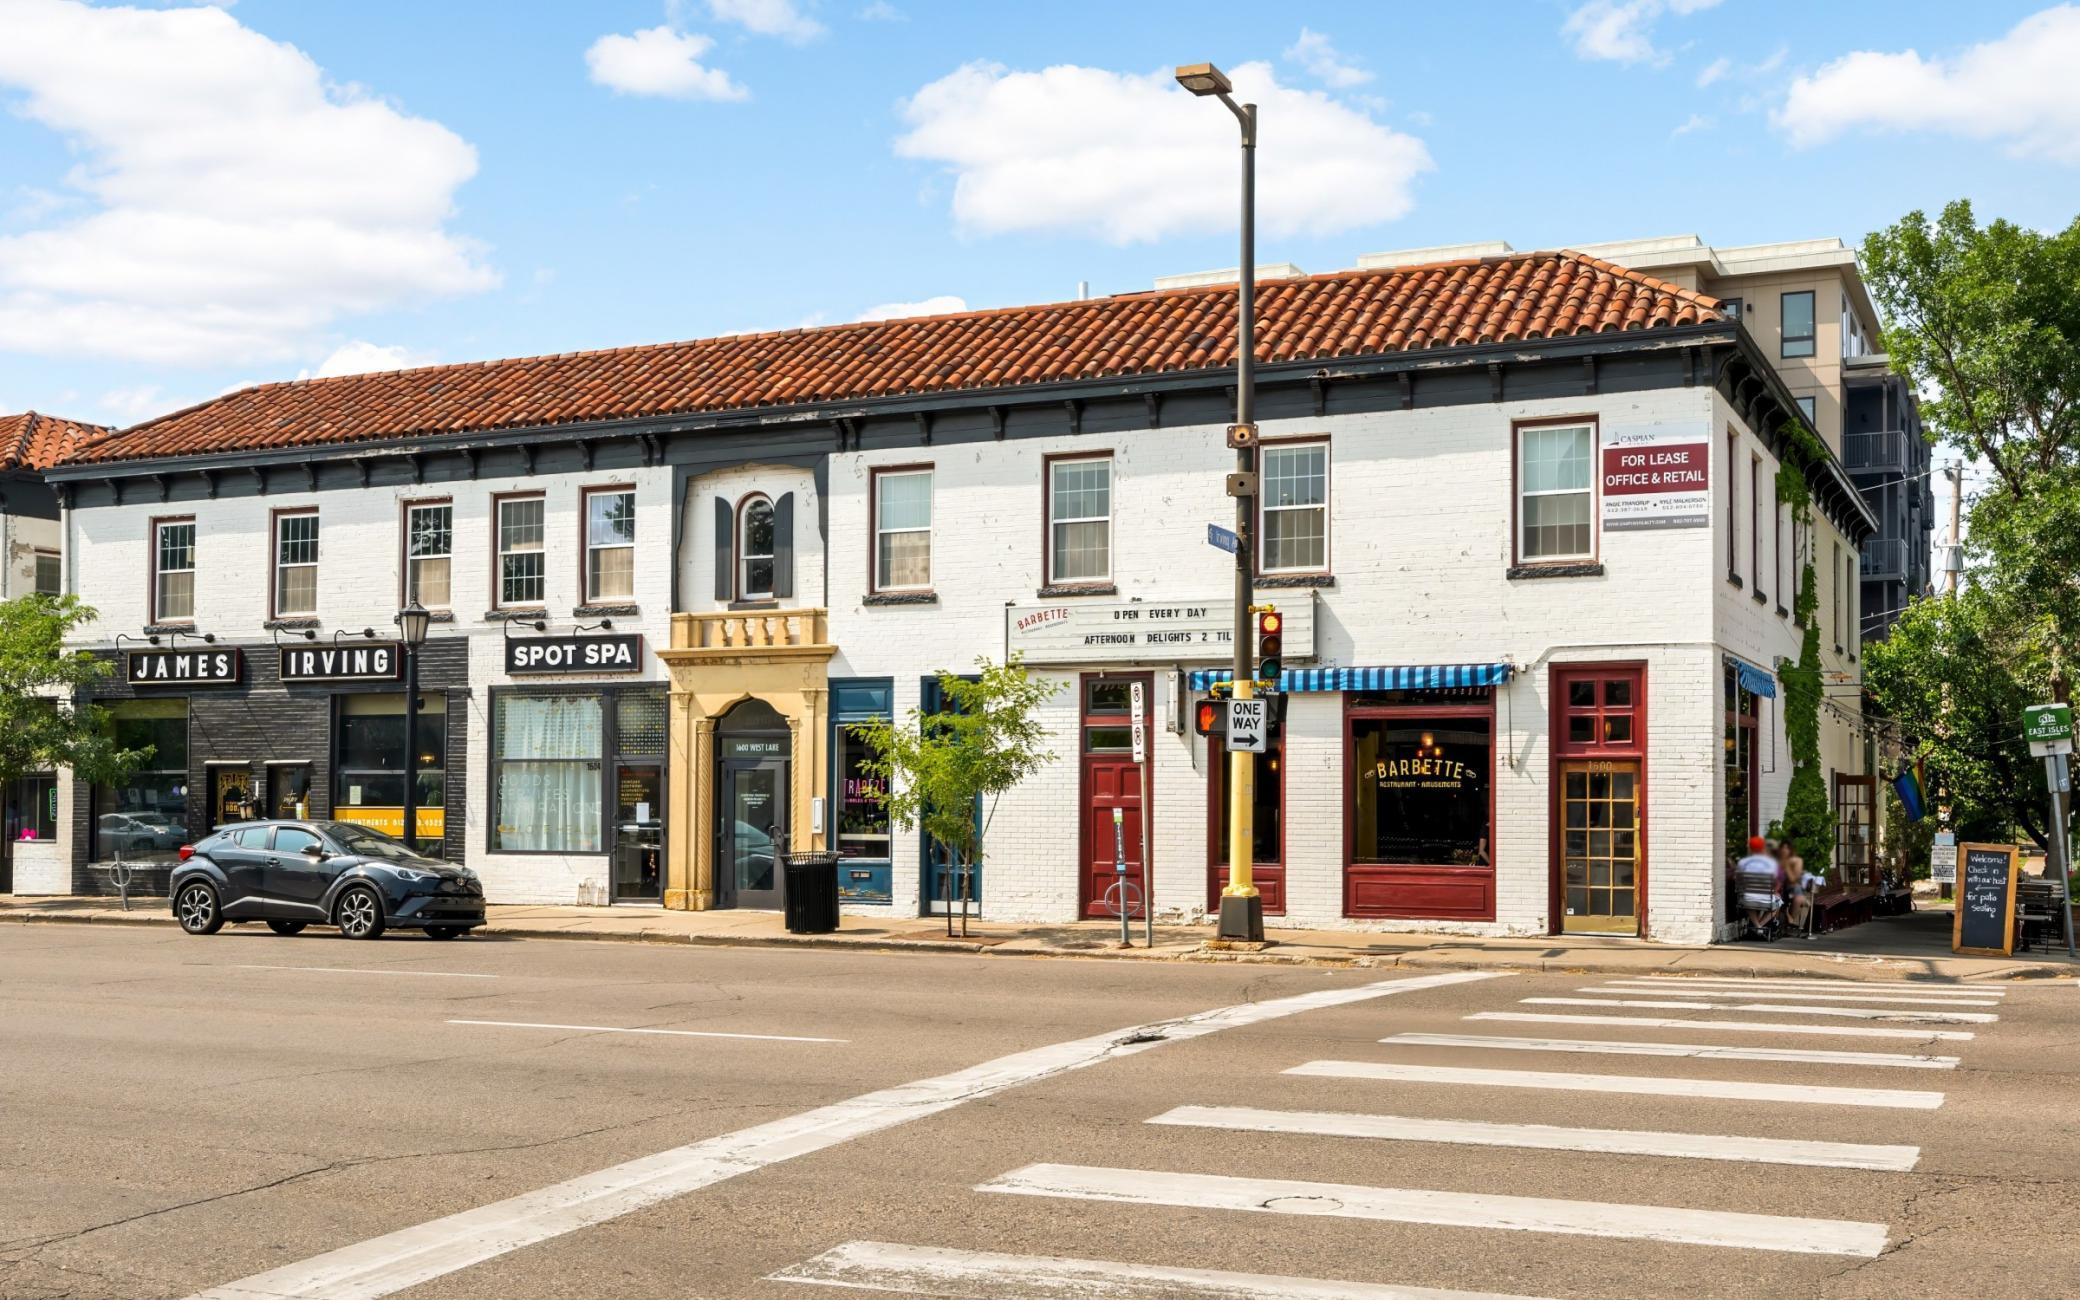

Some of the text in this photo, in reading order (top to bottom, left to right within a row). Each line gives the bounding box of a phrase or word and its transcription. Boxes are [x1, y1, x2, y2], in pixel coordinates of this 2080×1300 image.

[1620, 434, 1655, 443] CASPIAN
[1621, 452, 1689, 467] FOR LEASE
[1605, 470, 1705, 486] OFFICE & RETAIL
[1017, 608, 1068, 630] BARBETTE
[1114, 608, 1207, 620] OPEN EVERY DAY
[1084, 632, 1232, 645] AFTERNOON DELIGHTS 2 TIL
[514, 643, 632, 667] SPOT SPA
[136, 653, 229, 679] JAMES
[290, 649, 389, 675] IRVING
[1233, 703, 1261, 715] ONE
[1233, 717, 1261, 730] WAY
[2028, 727, 2046, 736] EAST
[2047, 725, 2070, 734] ISLES
[750, 743, 764, 752] WEST
[765, 743, 780, 752] LAKE
[1377, 758, 1465, 779] BARBETTE
[498, 774, 552, 787] GOODS
[1968, 865, 1988, 874] Check
